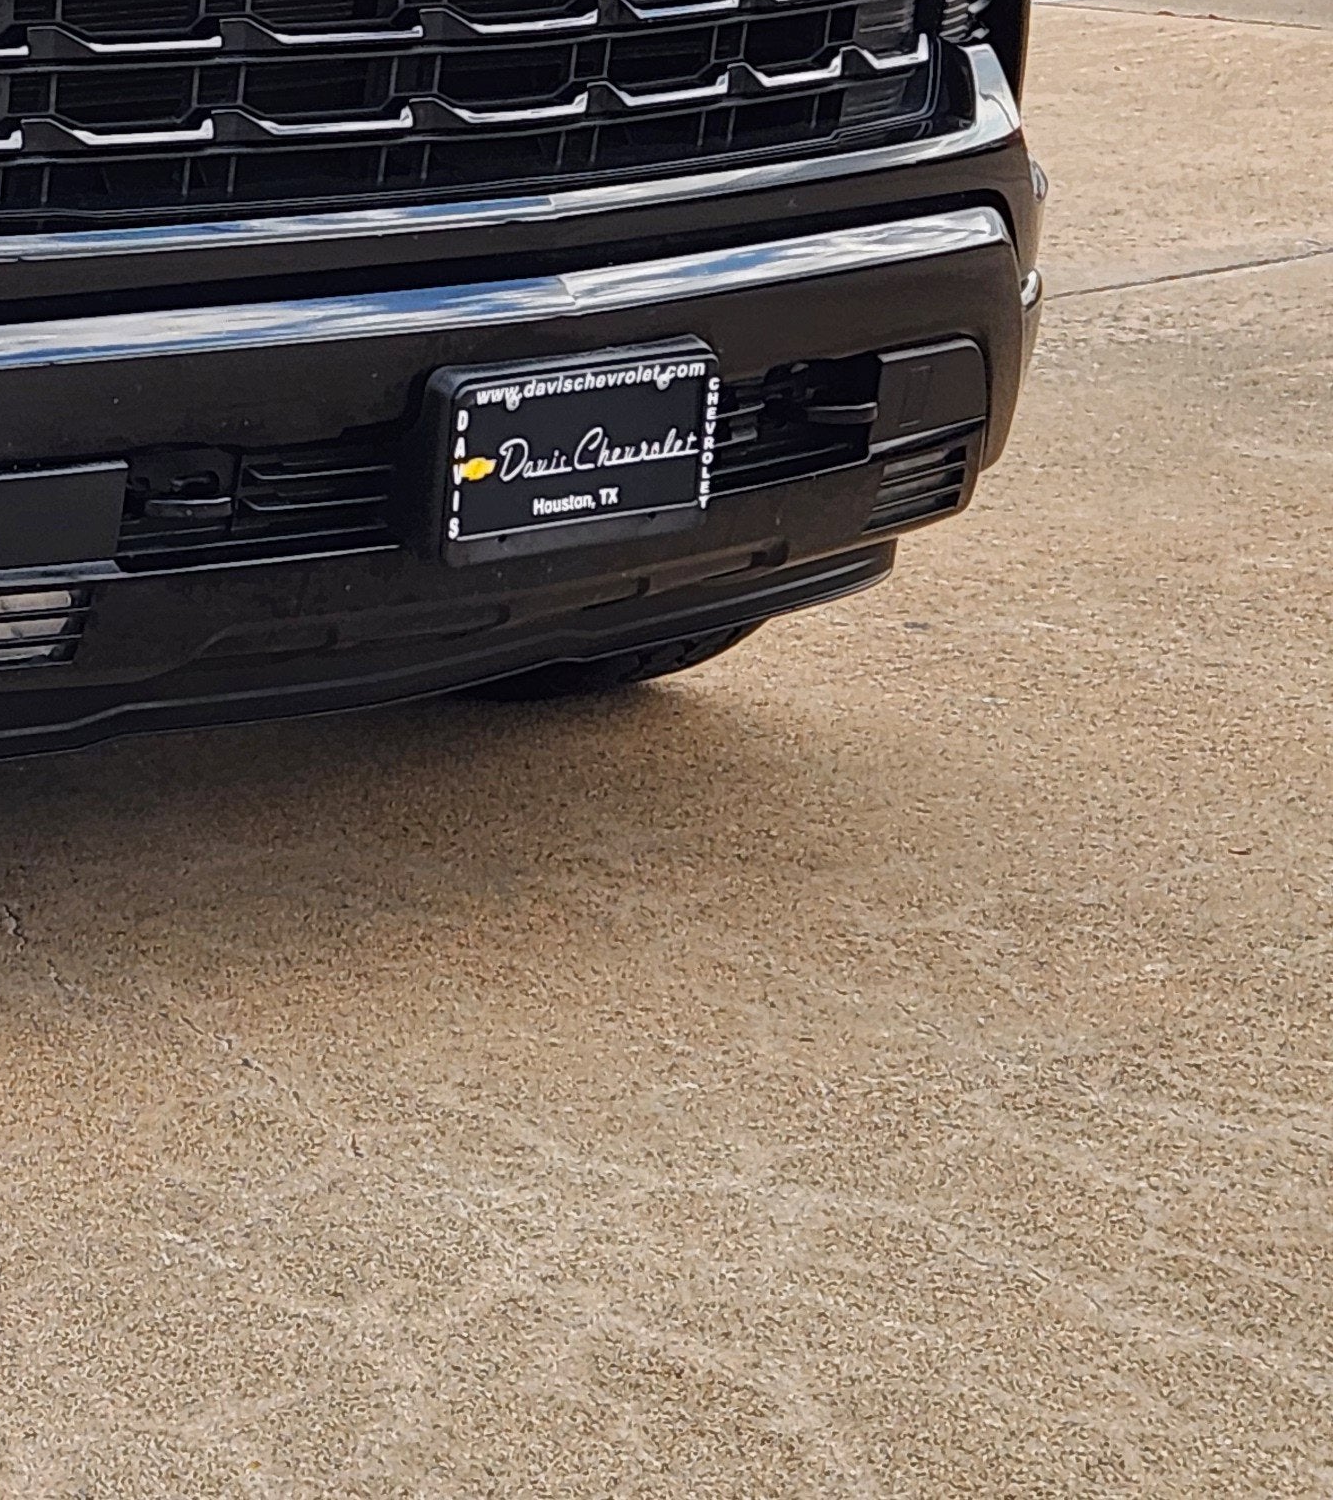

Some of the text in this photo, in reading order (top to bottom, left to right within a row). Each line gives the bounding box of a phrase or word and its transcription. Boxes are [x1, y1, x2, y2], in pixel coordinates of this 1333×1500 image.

[476, 362, 706, 406] www.davischevrolet.com
[499, 426, 700, 482] Davis Chevrolet
[698, 377, 721, 510] CHEVROLET
[448, 409, 469, 540] DAVIS
[533, 486, 619, 516] Houston, TX
